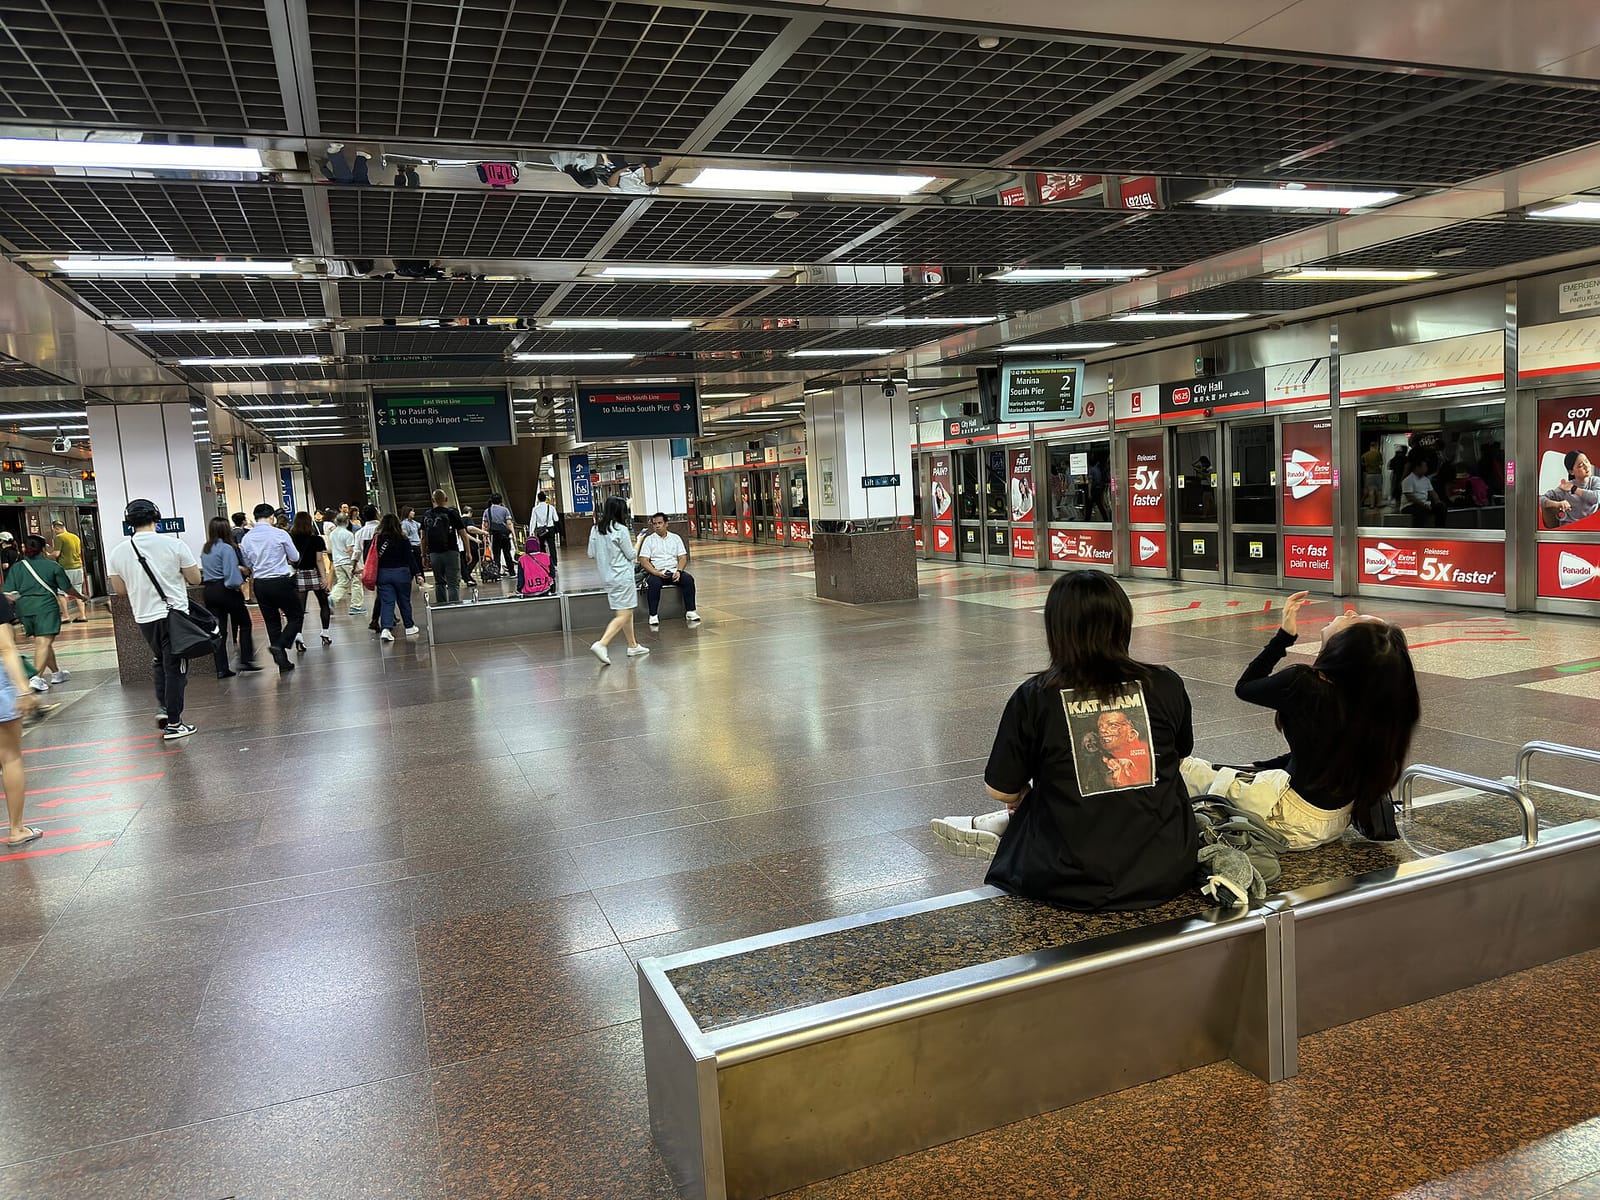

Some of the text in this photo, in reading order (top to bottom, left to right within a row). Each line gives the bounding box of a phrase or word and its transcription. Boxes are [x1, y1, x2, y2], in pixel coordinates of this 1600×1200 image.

[1562, 280, 1600, 293] EMERGEN
[1016, 376, 1040, 385] Marina
[1060, 375, 1071, 391] 2
[1010, 386, 1045, 396] South Pier
[1193, 380, 1223, 395] City Hall
[1133, 395, 1140, 406] C
[428, 407, 439, 415] Ris
[637, 404, 656, 412] South
[657, 404, 670, 412] Pier
[1568, 408, 1593, 419] GOT
[409, 417, 434, 426] Changi
[436, 416, 460, 426] Airport
[1016, 458, 1028, 466] FAST
[1136, 454, 1156, 462] Releases
[1014, 465, 1032, 474] RELIEF
[1134, 466, 1160, 490] 5x
[166, 521, 180, 530] Lift
[1078, 541, 1093, 558] 5x
[1291, 544, 1328, 556] For fast
[1424, 548, 1450, 556] Releases
[1290, 558, 1330, 570] pain relief.
[1419, 558, 1453, 582] 5x
[1562, 566, 1590, 575] Panadol
